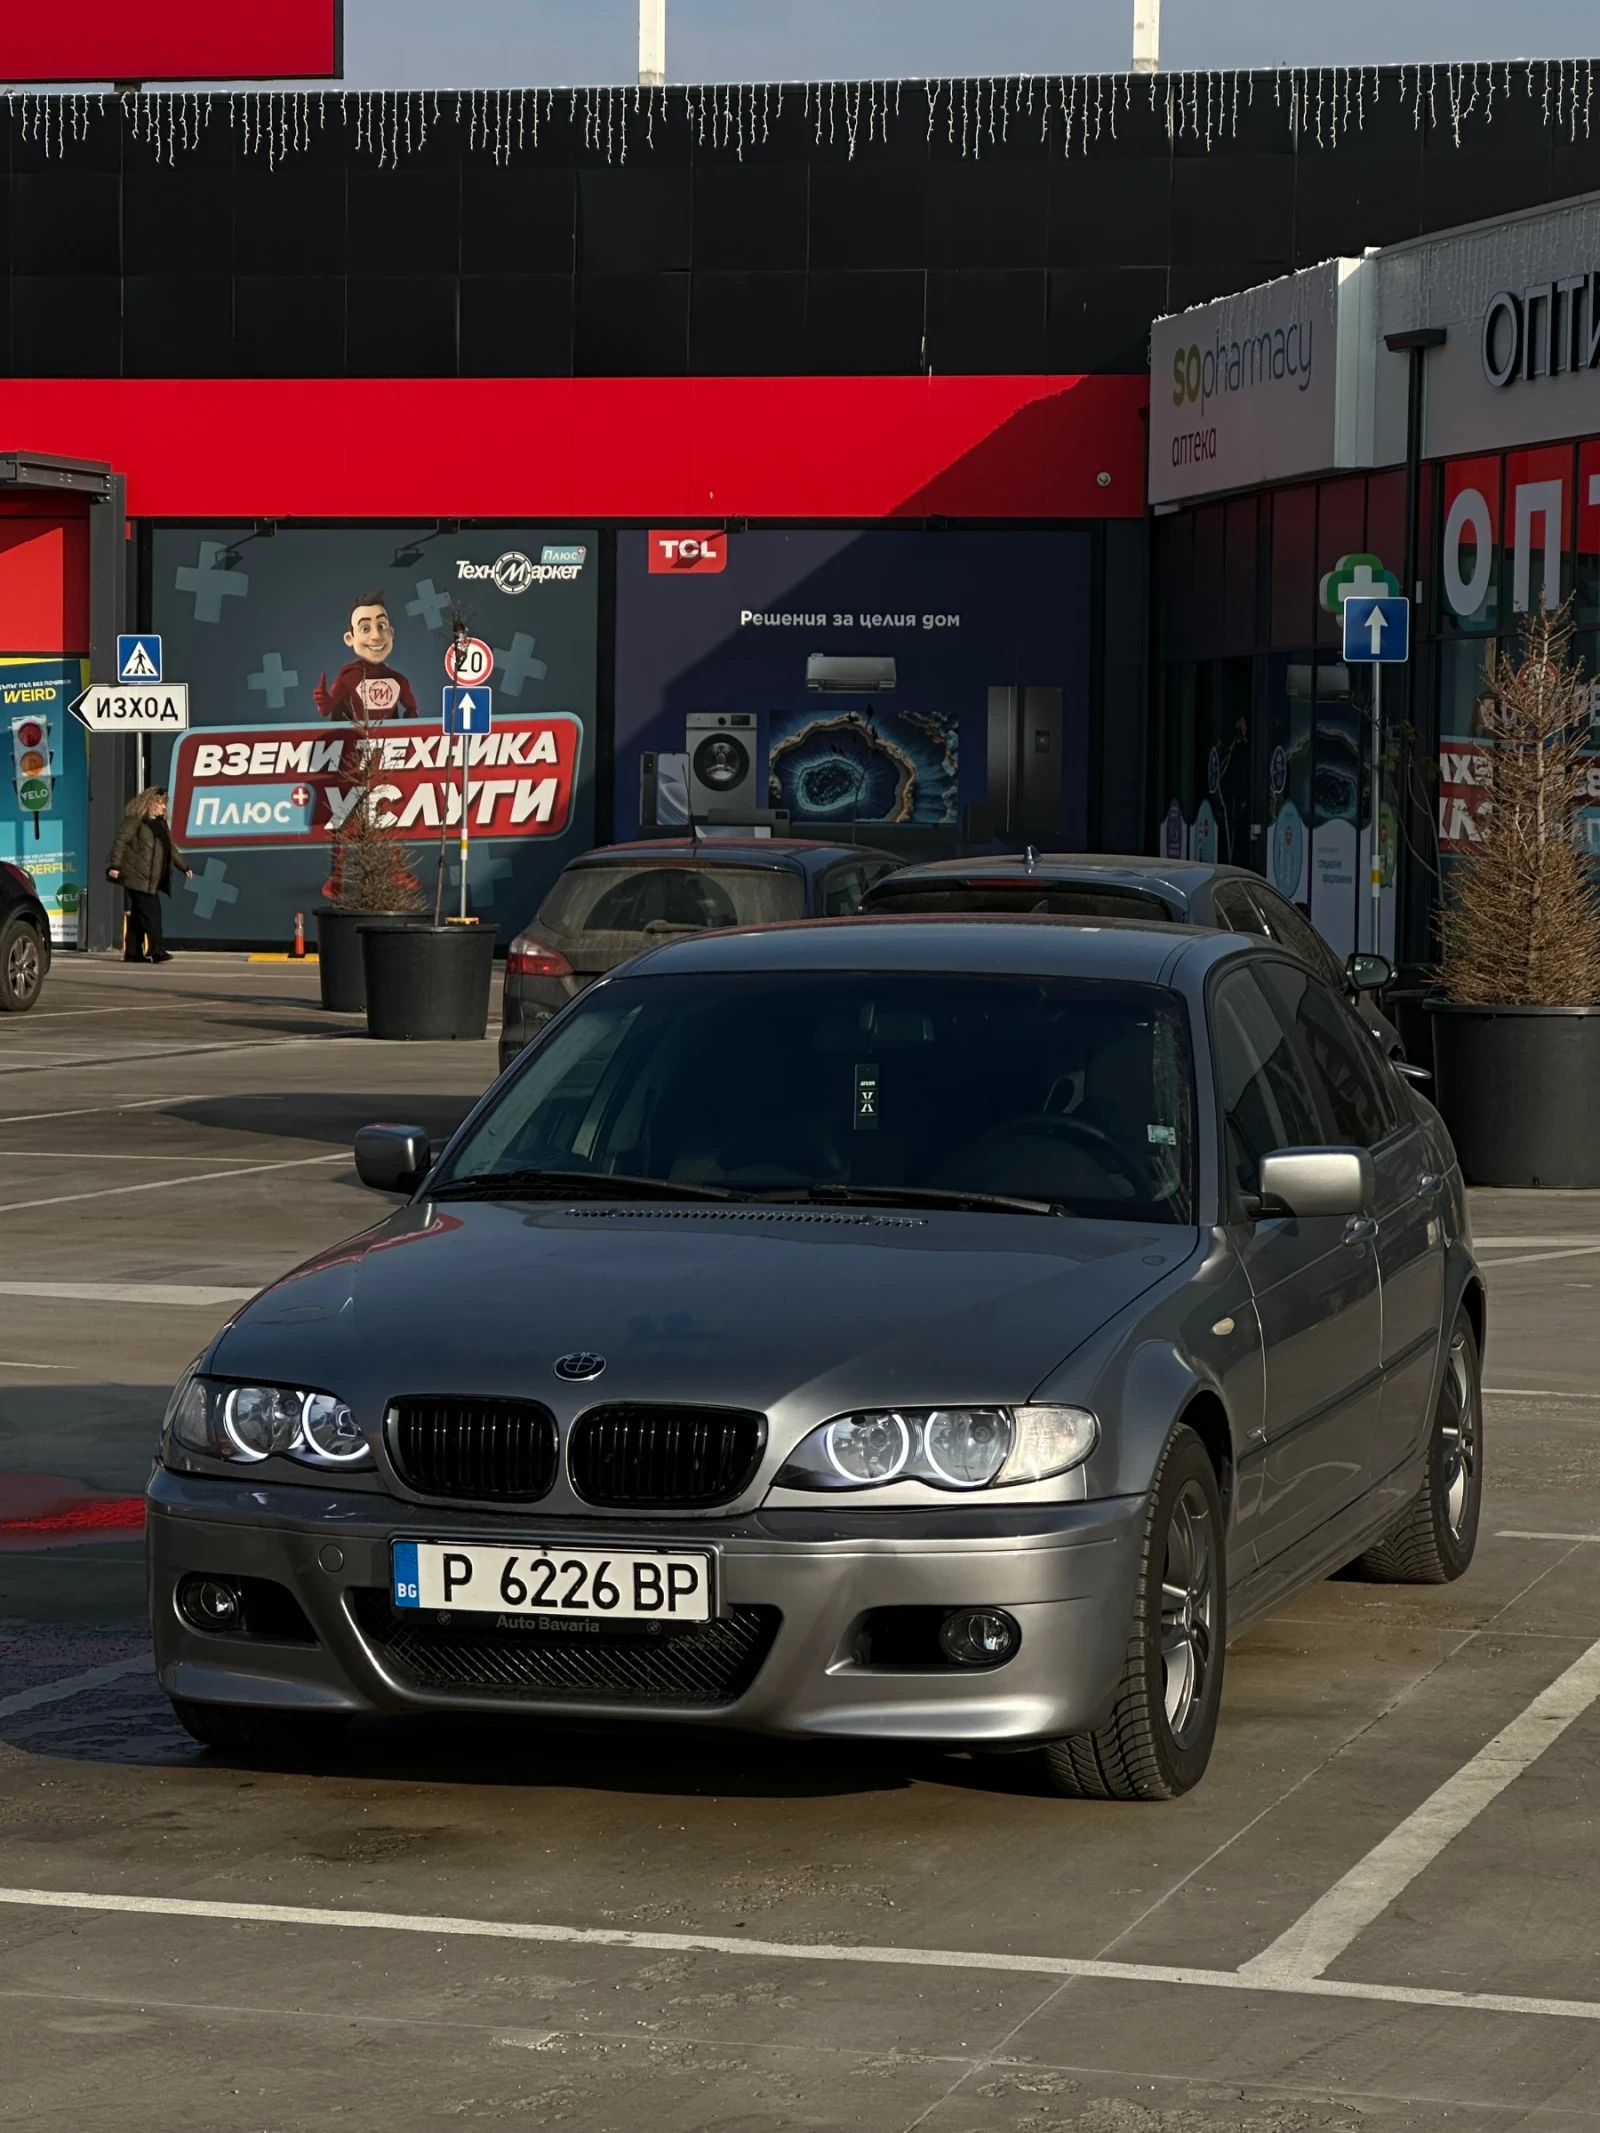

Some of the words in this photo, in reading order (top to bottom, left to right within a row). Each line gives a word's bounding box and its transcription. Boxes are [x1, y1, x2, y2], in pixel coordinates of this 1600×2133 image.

[1482, 271, 1600, 387] ОПТ
[1173, 320, 1313, 417] sopharmacy
[1172, 428, 1217, 467] аптека
[659, 539, 717, 558] TCL
[1443, 474, 1600, 616] ОП
[740, 610, 827, 626] Решения
[833, 614, 854, 626] за
[860, 614, 916, 628] целия
[922, 614, 960, 629] дом
[4, 687, 57, 704] WEIRD
[96, 697, 179, 722] ИЗХОД
[192, 740, 345, 777] ВЗЕМИ
[354, 731, 558, 770] ТЕХНИКА
[21, 788, 49, 801] VELO
[323, 778, 558, 830] УСЛУГИ
[397, 1583, 417, 1598] BG
[443, 1553, 473, 1602] P
[500, 1556, 620, 1610] 6226
[633, 1561, 699, 1612] BP
[496, 1614, 536, 1630] Auto
[539, 1616, 600, 1633] Bavaria
